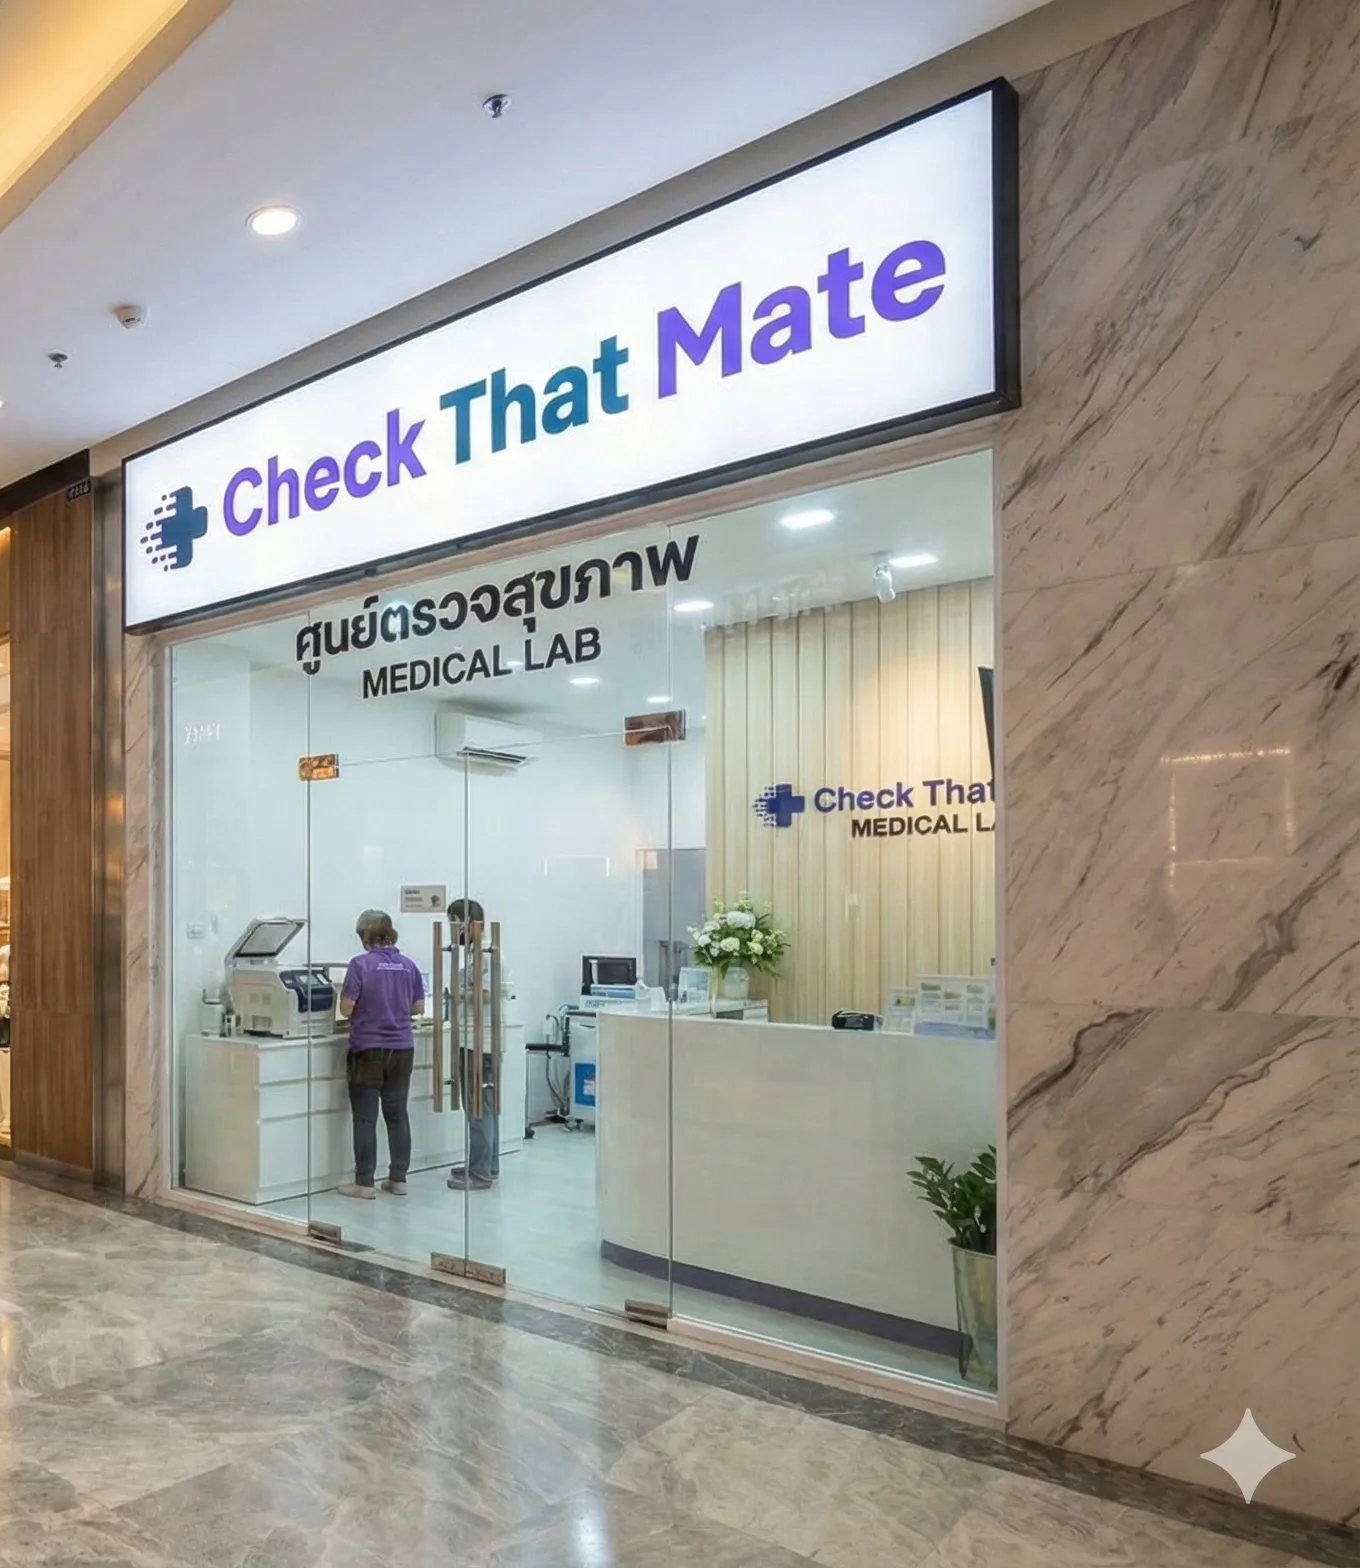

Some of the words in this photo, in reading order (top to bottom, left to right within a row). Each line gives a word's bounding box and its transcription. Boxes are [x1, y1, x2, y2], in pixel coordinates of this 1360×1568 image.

[223, 410, 426, 537] Check
[439, 335, 629, 465] That
[656, 239, 947, 399] Mate
[296, 534, 700, 676] ศูนย์ตรวจสุขภาพ
[363, 644, 512, 699] MEDICAL
[524, 627, 602, 671] LAB
[814, 782, 914, 814] Check
[852, 814, 968, 839] MEDICAL
[976, 812, 996, 832] L
